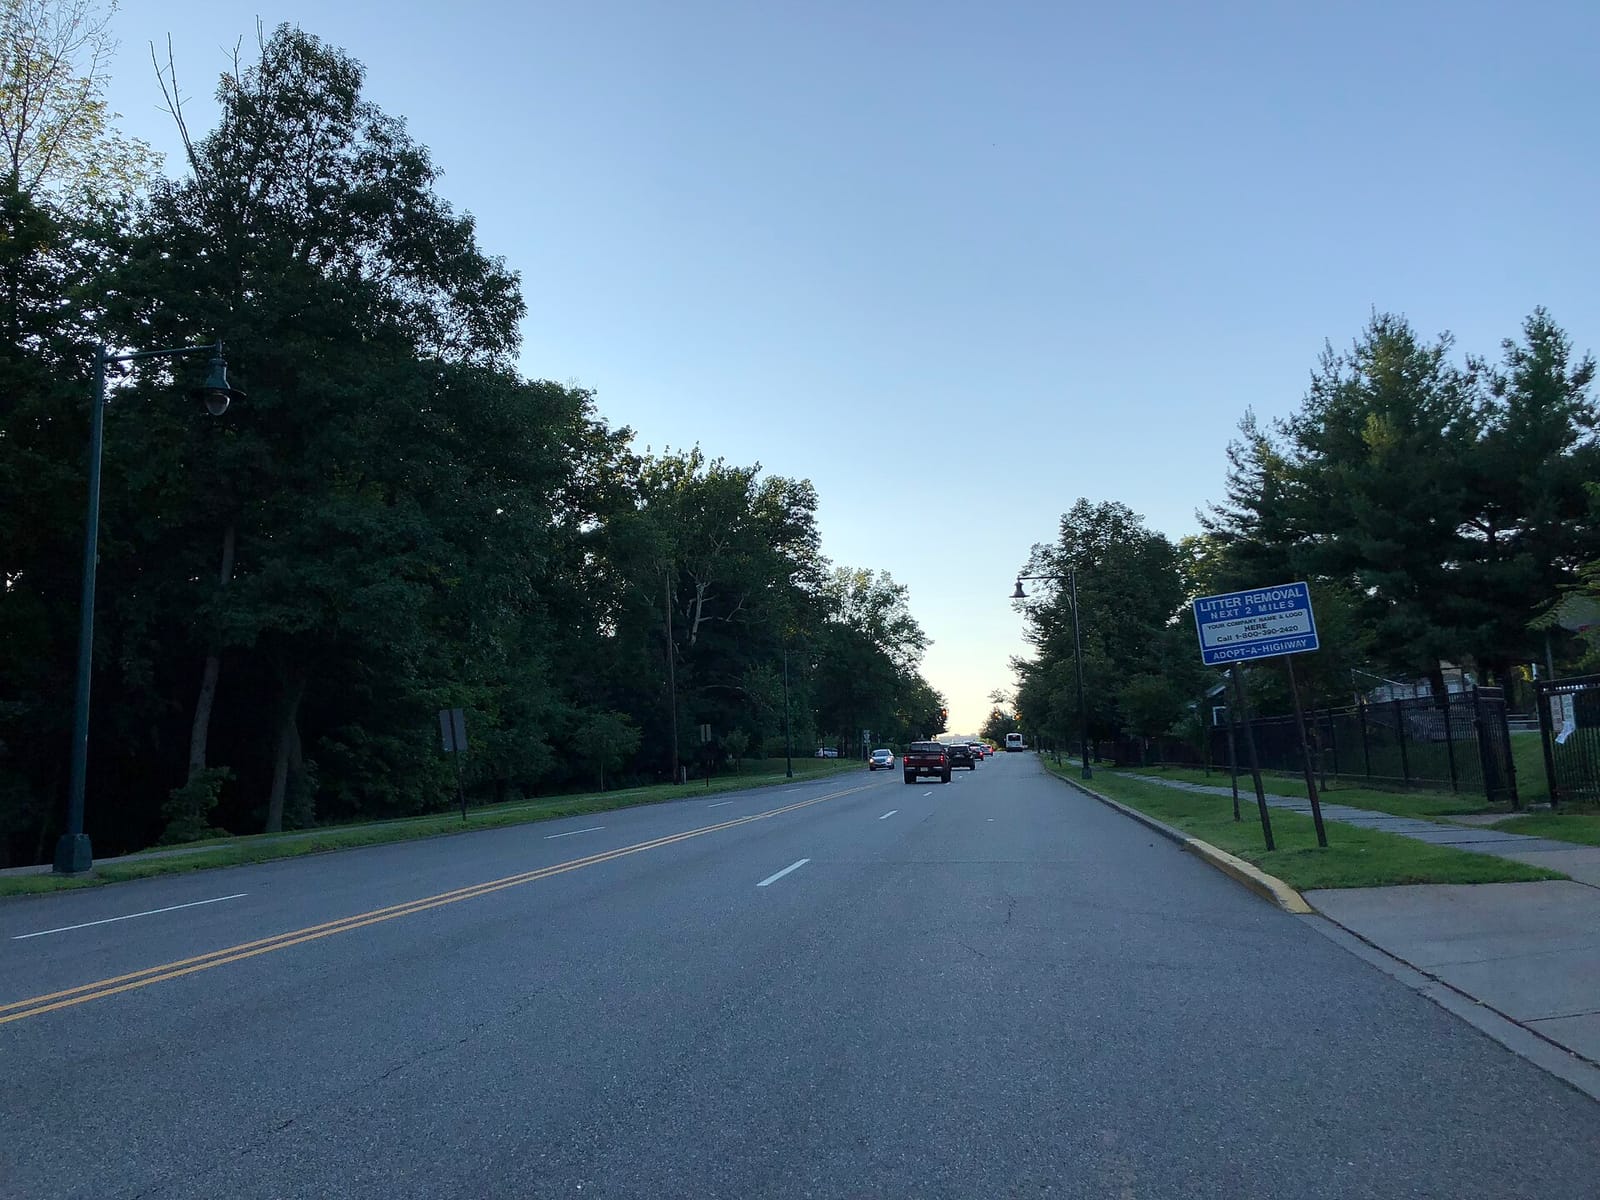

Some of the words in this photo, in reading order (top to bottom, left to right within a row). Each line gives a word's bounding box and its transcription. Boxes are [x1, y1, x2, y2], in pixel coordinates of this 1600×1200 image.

[1200, 597, 1241, 611] LITTER
[1245, 588, 1303, 605] REMOVAL
[1211, 608, 1240, 619] NEXT
[1259, 600, 1294, 612] MILES
[1227, 618, 1256, 627] COMPANY
[1244, 623, 1267, 632] HERE
[1213, 640, 1307, 660] ADOPT-A-HIGHWAY
